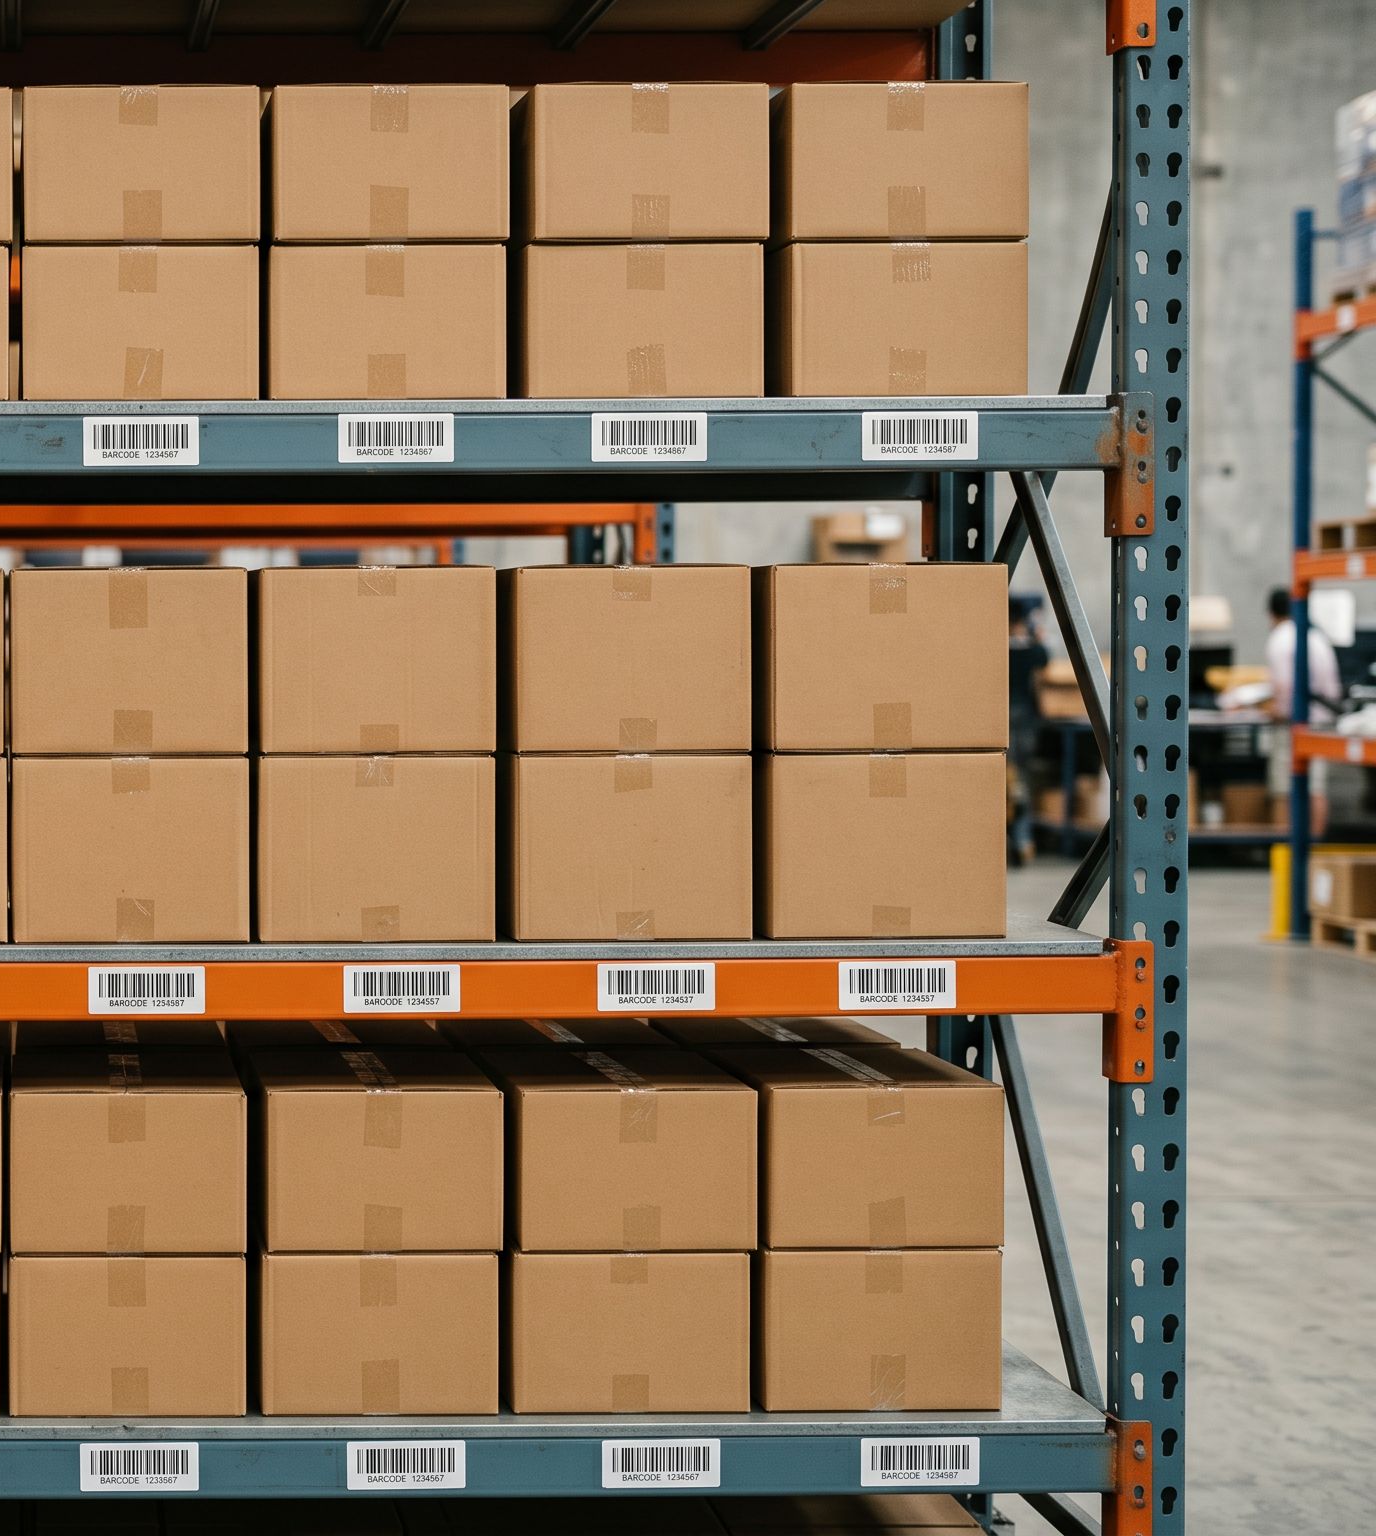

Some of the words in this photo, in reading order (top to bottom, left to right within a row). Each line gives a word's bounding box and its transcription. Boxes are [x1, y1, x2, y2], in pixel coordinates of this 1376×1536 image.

[145, 450, 179, 459] 1234567
[356, 447, 394, 456] BARCODE
[610, 446, 648, 455] BARCODE
[618, 995, 657, 1004] BARCODE
[859, 994, 898, 1003] BARCODE
[367, 1474, 407, 1483] BARCODE
[412, 1474, 445, 1483] 1234567
[621, 1473, 662, 1482] BARCODE
[666, 1473, 700, 1482] 1234567
[881, 1471, 921, 1480] BARCODE
[100, 1476, 140, 1485] BARCODE
